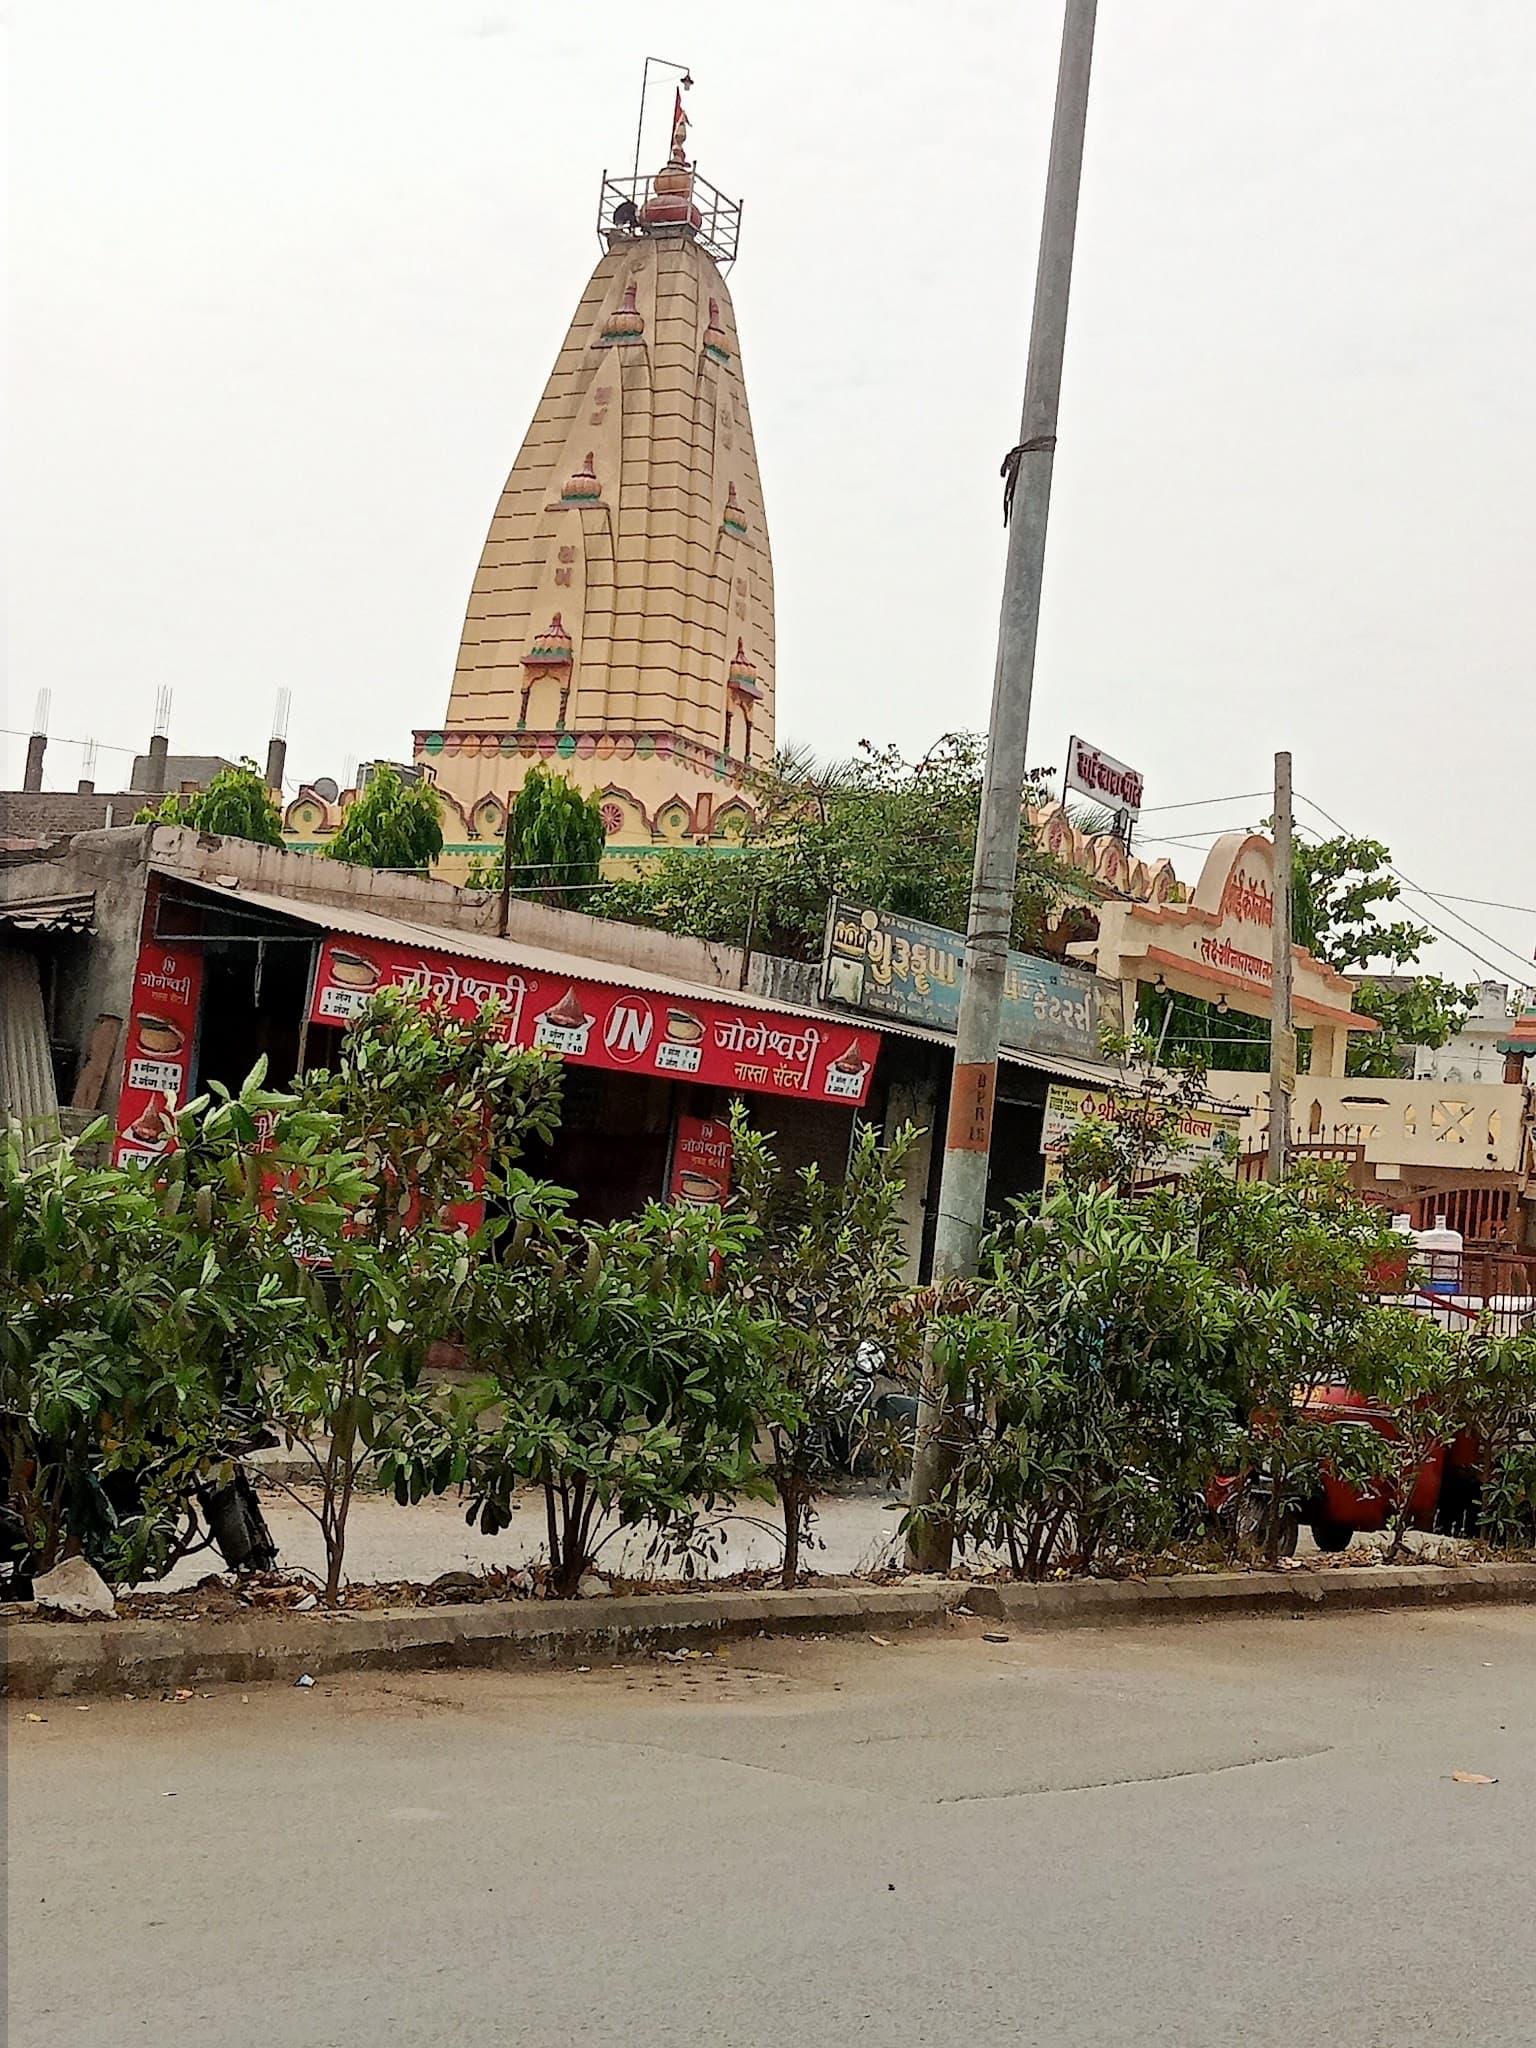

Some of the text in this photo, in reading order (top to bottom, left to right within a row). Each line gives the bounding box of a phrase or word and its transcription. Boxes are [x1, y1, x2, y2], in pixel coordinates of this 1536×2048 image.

[573, 1045, 583, 1053] 10
[714, 1017, 821, 1091] जोगेश्वरी
[734, 1062, 804, 1090] नास्ता सेंटर
